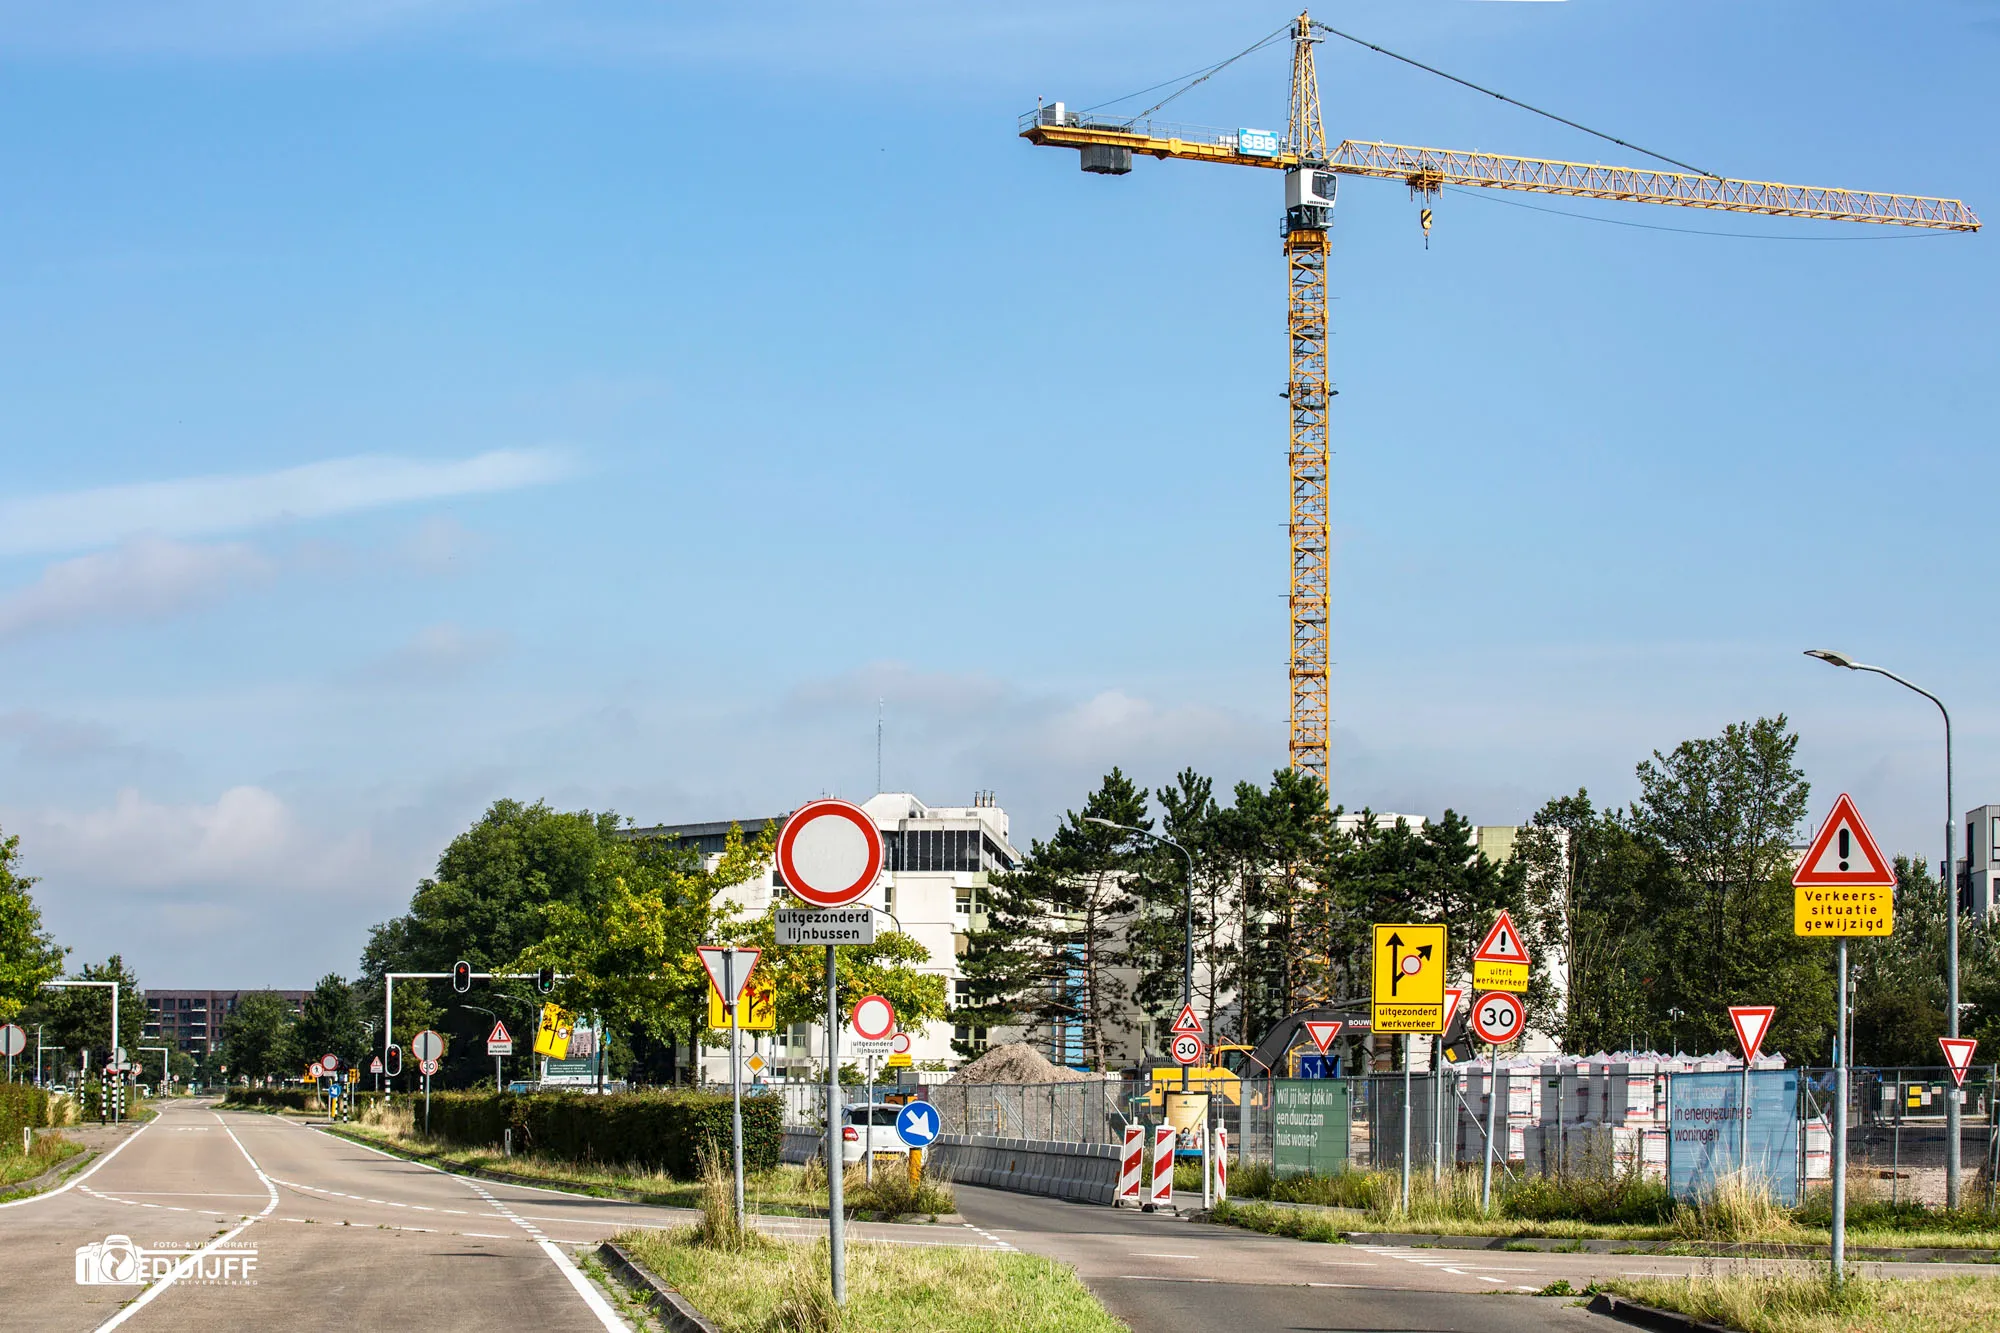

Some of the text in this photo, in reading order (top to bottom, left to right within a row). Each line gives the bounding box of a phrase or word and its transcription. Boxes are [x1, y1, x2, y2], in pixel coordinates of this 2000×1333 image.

[1241, 134, 1277, 151] SBB
[1804, 891, 1883, 901] Verkeers-
[1811, 904, 1877, 915] situatie
[778, 911, 869, 927] uitgezonderd
[1804, 918, 1883, 931] gewijzigd
[788, 927, 860, 943] lijnbussen
[1490, 968, 1513, 976] uitrit
[1475, 977, 1526, 987] werkverkeer
[1379, 1007, 1437, 1018] uitgezonderd
[1482, 1007, 1514, 1028] 30
[1381, 1019, 1436, 1028] werkverkeer
[1177, 1042, 1197, 1054] 30
[1276, 1087, 1289, 1105] Wil
[1289, 1088, 1297, 1109] jij
[1297, 1087, 1312, 1105] hier
[1326, 1090, 1333, 1105] in
[1276, 1109, 1324, 1126] een duurzaam
[1674, 1104, 1683, 1121] in
[1276, 1129, 1318, 1147] huis wonen?
[1674, 1125, 1720, 1145] woningen
